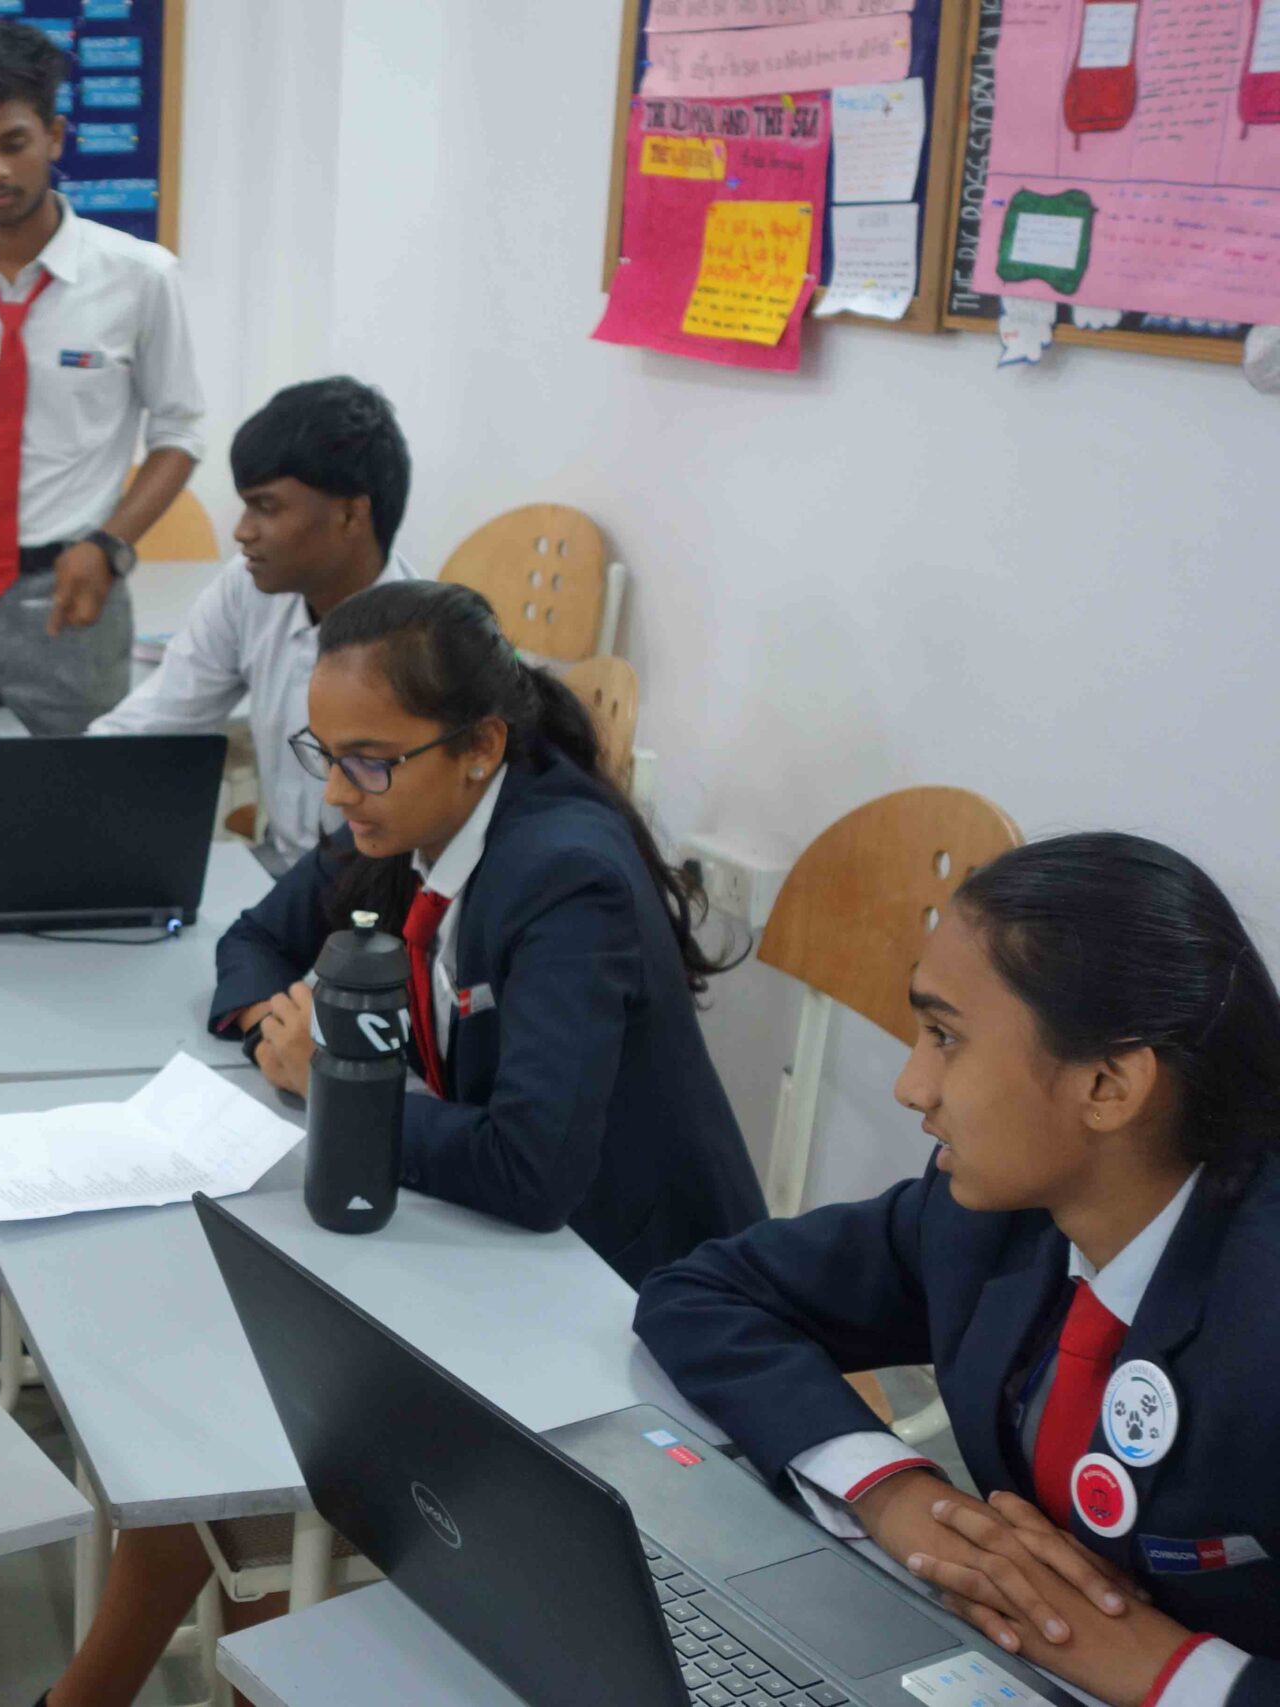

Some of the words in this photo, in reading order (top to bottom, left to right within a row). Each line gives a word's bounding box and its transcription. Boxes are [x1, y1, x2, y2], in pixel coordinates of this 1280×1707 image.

[719, 107, 750, 136] AND
[753, 105, 784, 136] THE
[789, 105, 820, 138] SEA
